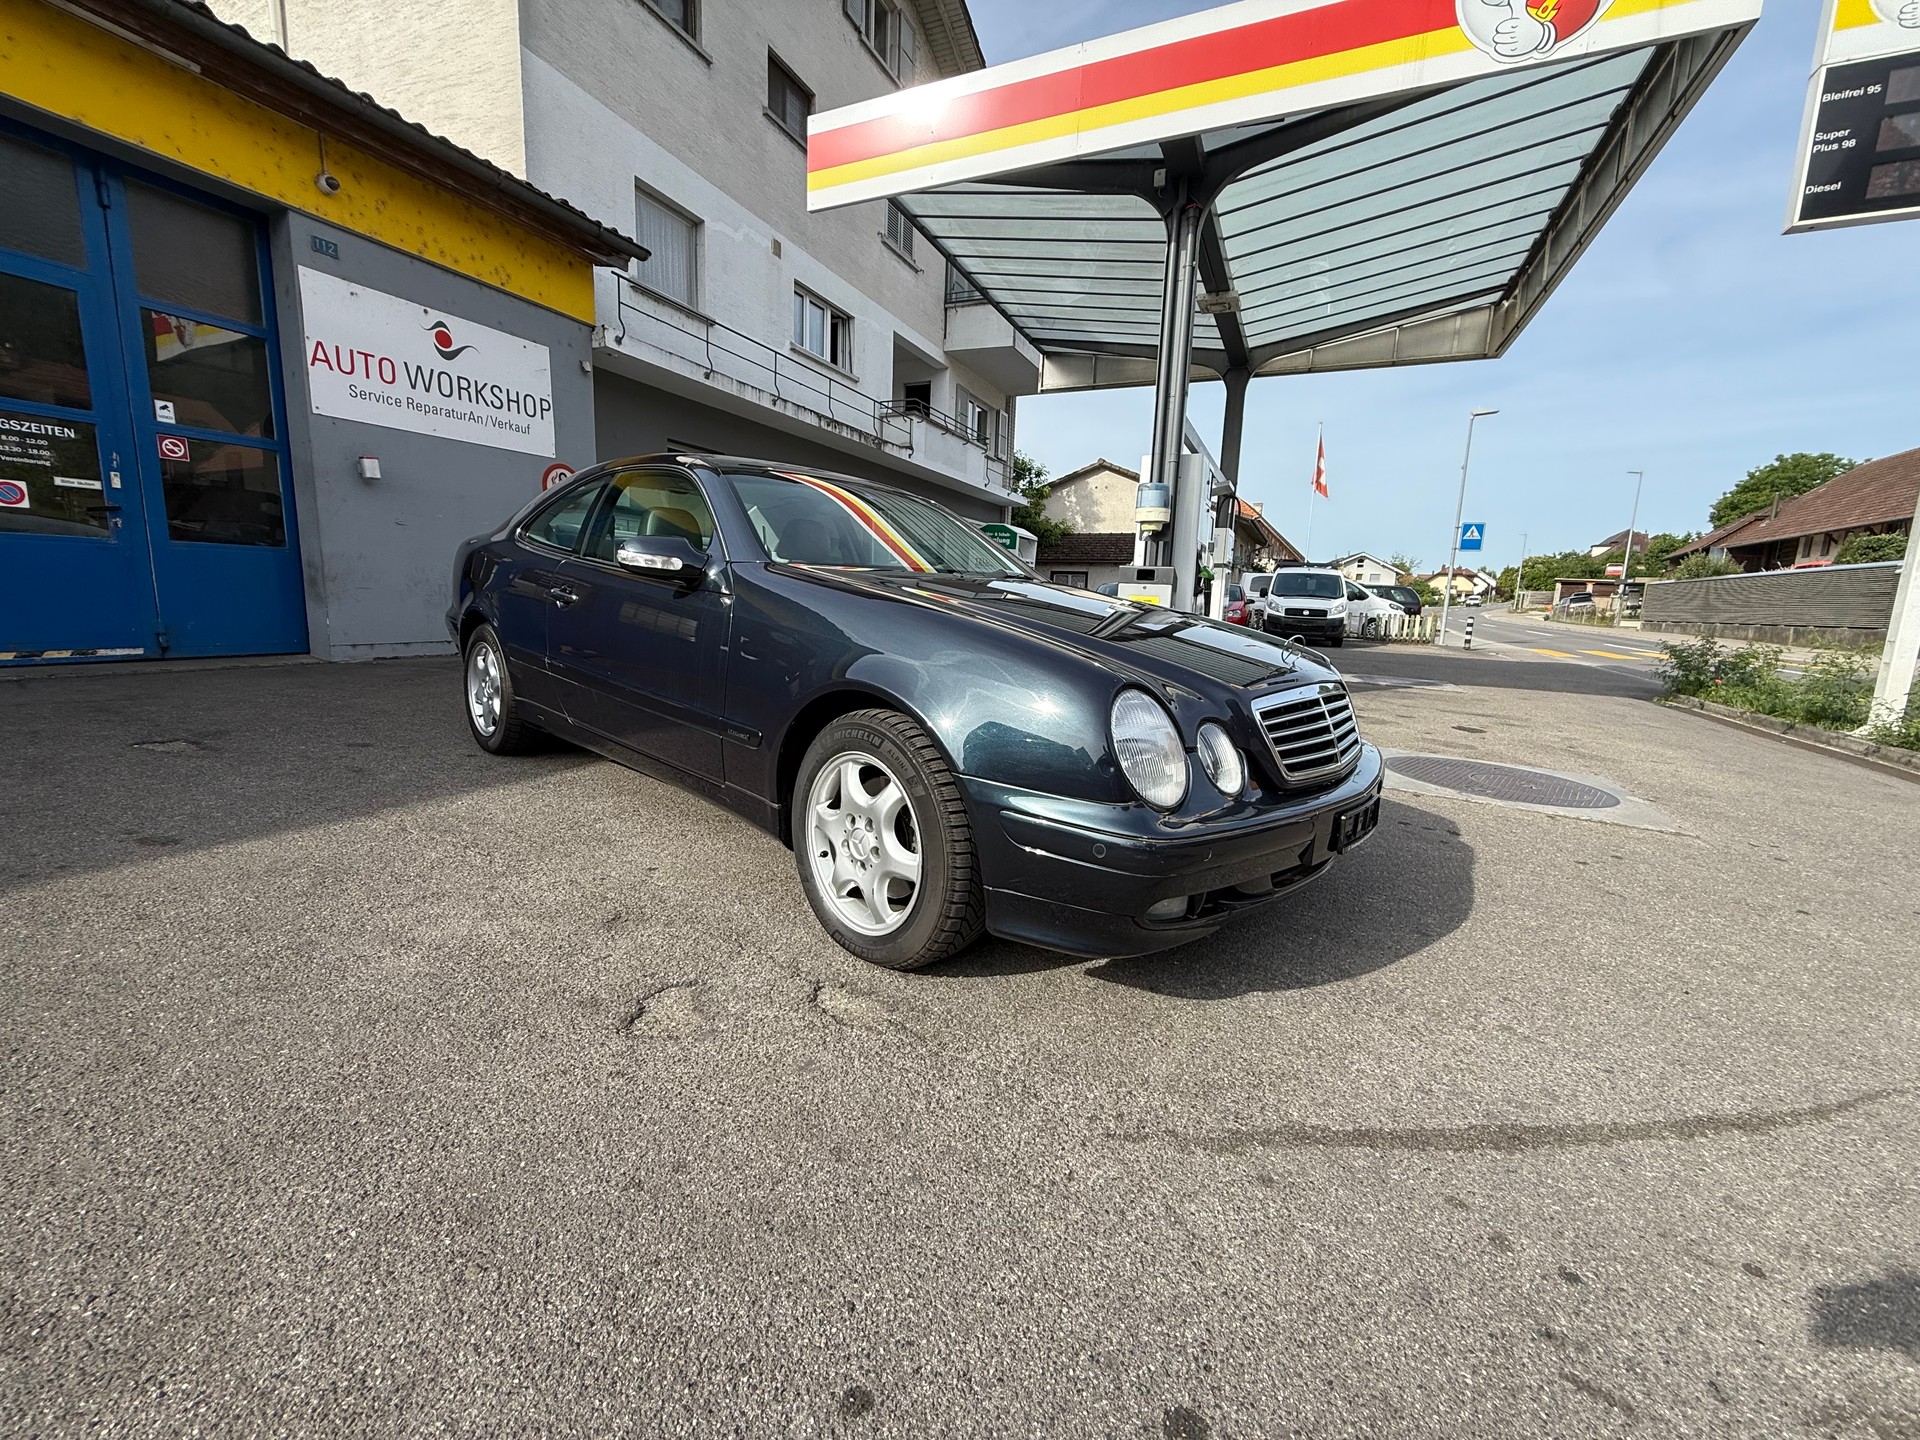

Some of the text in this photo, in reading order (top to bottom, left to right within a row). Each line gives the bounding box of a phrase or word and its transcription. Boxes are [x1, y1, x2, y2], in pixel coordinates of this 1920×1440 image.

[1822, 84, 1882, 103] Bleifrei 95
[1815, 128, 1851, 142] Super
[1813, 138, 1857, 154] Plus 98
[1805, 181, 1842, 195] Diesel
[313, 238, 337, 256] 112
[310, 340, 552, 421] AUTO WORKSHOP
[348, 383, 531, 436] Service ReparaturAn/Verkauf
[25, 437, 48, 446] 12.00
[833, 728, 883, 748] MICHELIN
[886, 748, 907, 769] ALPIN
